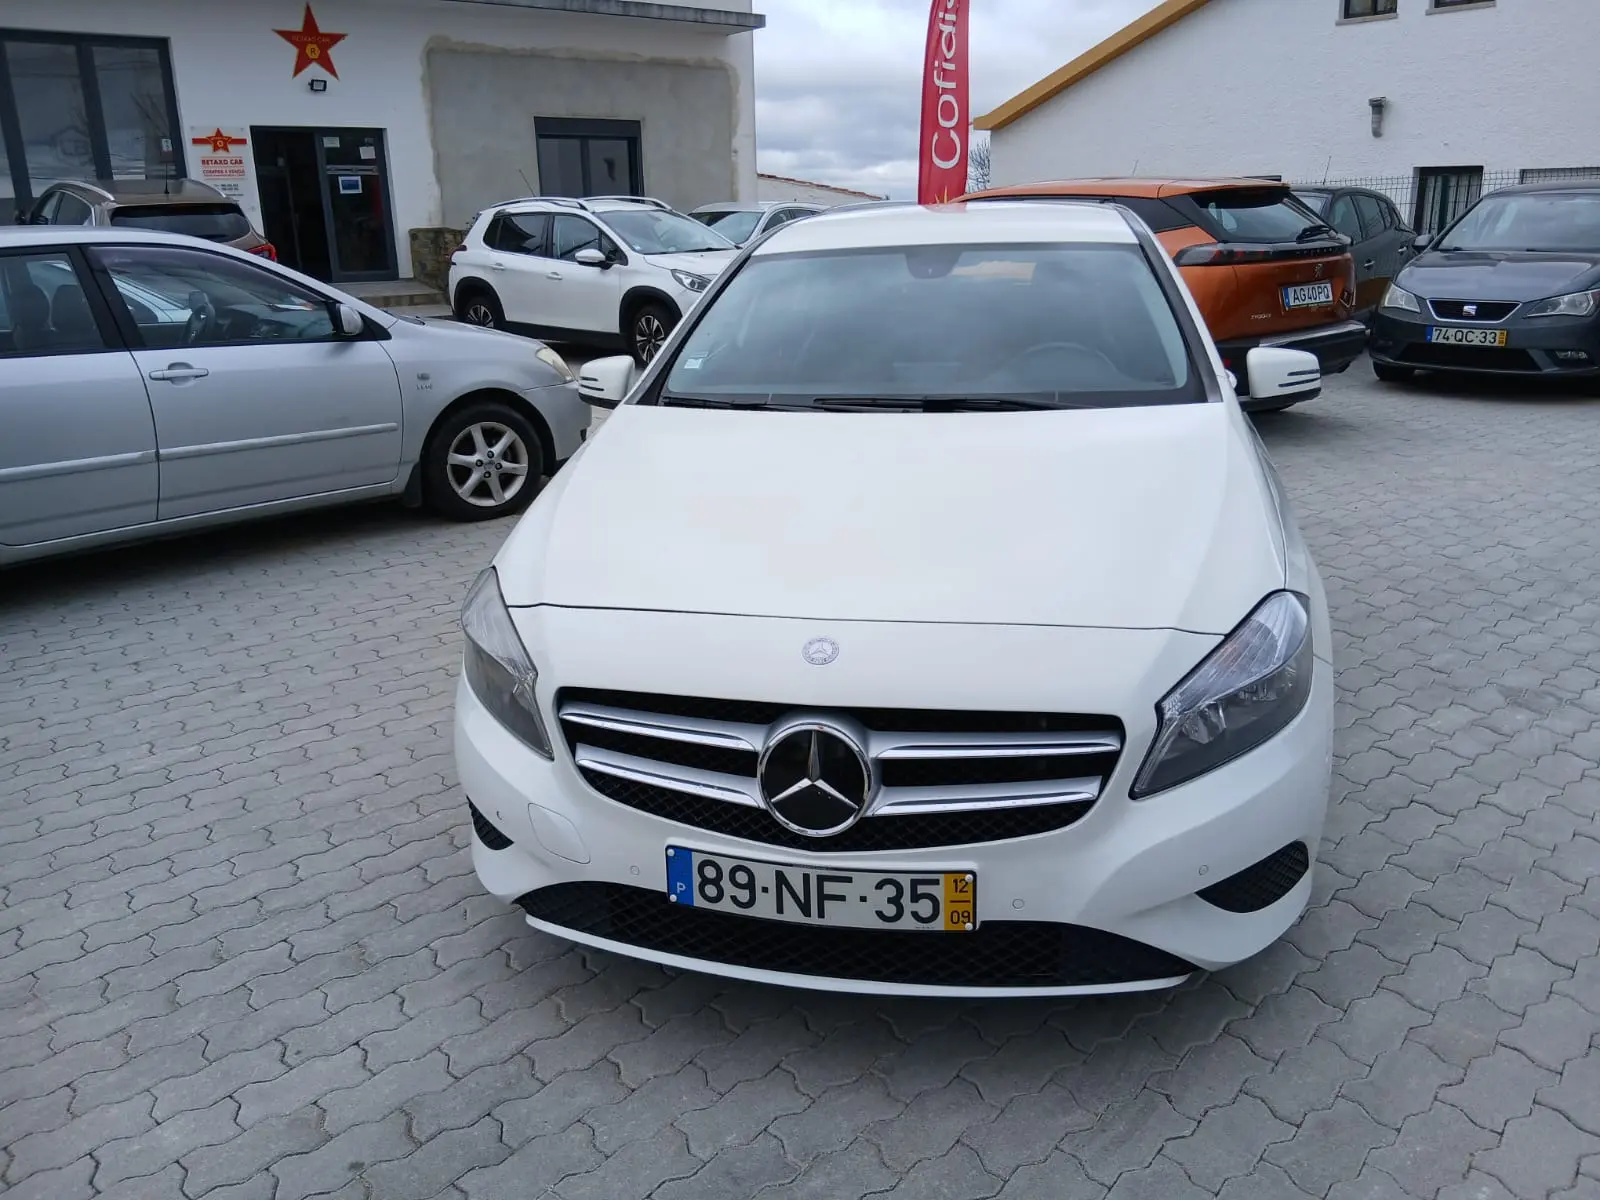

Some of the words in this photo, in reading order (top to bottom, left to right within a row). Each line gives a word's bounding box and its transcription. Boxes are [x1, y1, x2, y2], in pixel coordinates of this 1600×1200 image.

[310, 48, 317, 56] R
[1293, 286, 1330, 304] AG40PQ
[676, 882, 686, 894] P
[952, 878, 969, 893] 12
[950, 910, 971, 925] 09
